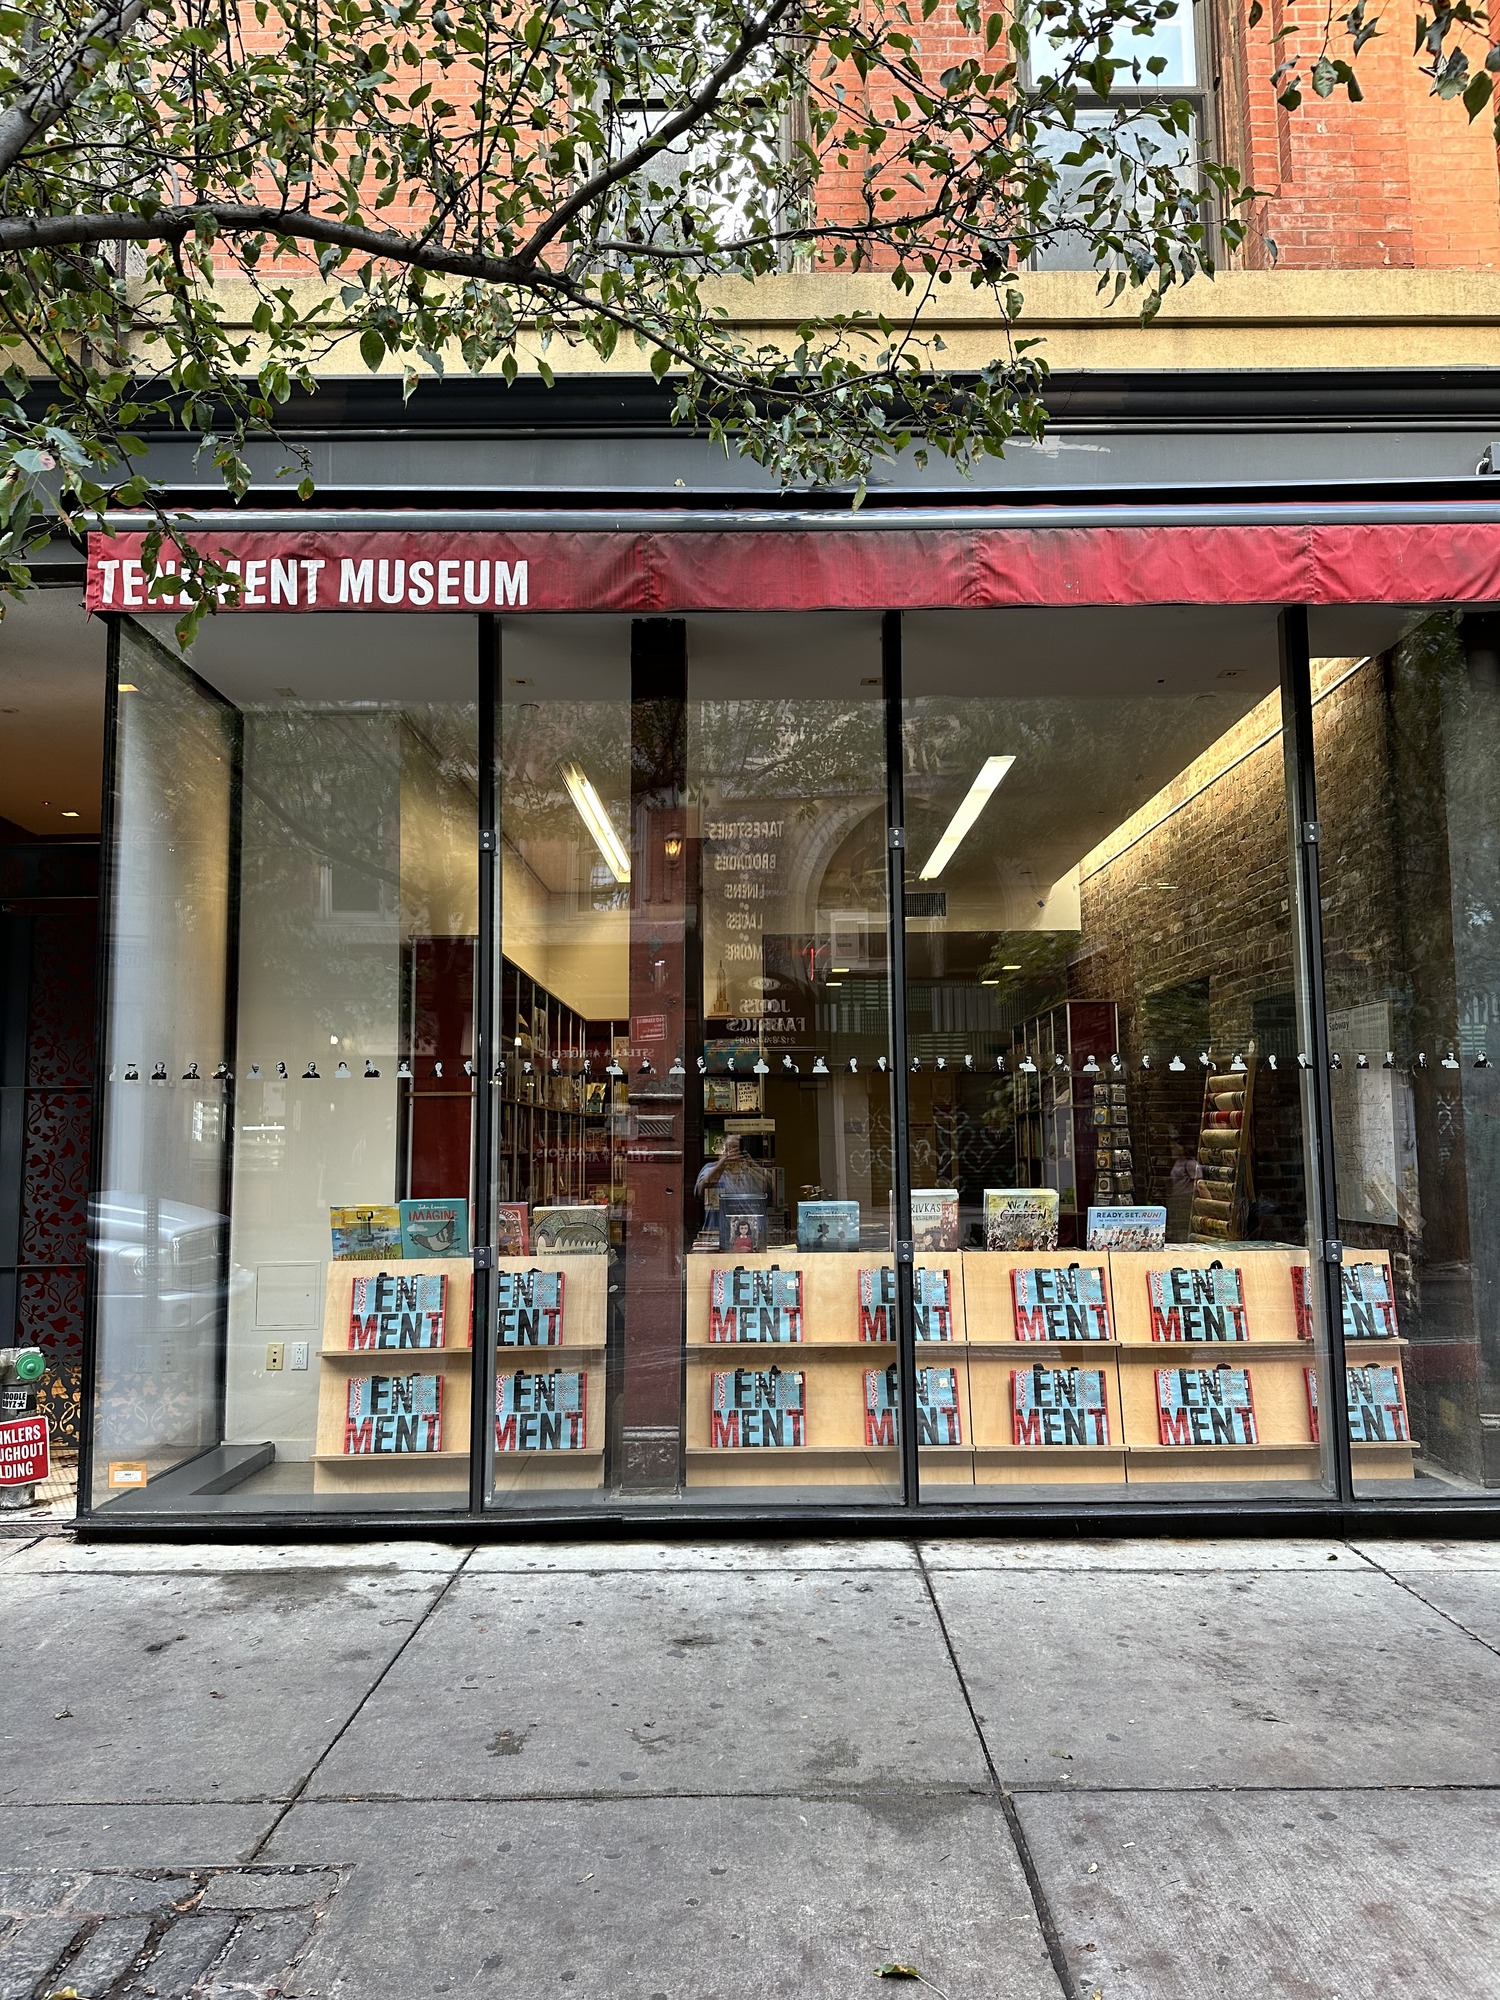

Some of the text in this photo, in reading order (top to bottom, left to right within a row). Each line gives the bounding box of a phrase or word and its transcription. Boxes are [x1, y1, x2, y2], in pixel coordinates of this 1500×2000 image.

[339, 559, 528, 606] MUSEUM
[1328, 1021, 1350, 1032] Subway
[408, 1209, 459, 1221] IMAGINE
[1001, 1208, 1047, 1220] GARDEN
[1007, 1200, 1021, 1209] We
[339, 1253, 397, 1261] IMMIGRANTS
[353, 1275, 438, 1313] TENE
[714, 1270, 794, 1306] TENE
[1015, 1268, 1099, 1304] TENE
[1150, 1269, 1235, 1305] TENE
[350, 1313, 442, 1349] MENT
[711, 1307, 801, 1342] MENT
[1018, 1304, 1109, 1341] MENT
[1153, 1305, 1245, 1341] MENT
[349, 1376, 438, 1415] TENE
[714, 1371, 798, 1409] TENE
[1016, 1370, 1099, 1407] TENE
[1159, 1369, 1242, 1406] TENE
[345, 1414, 440, 1452] MENT
[496, 1412, 584, 1450] MENT
[713, 1409, 804, 1447] MENT
[1016, 1407, 1106, 1445] MENT
[1161, 1407, 1254, 1444] MENT
